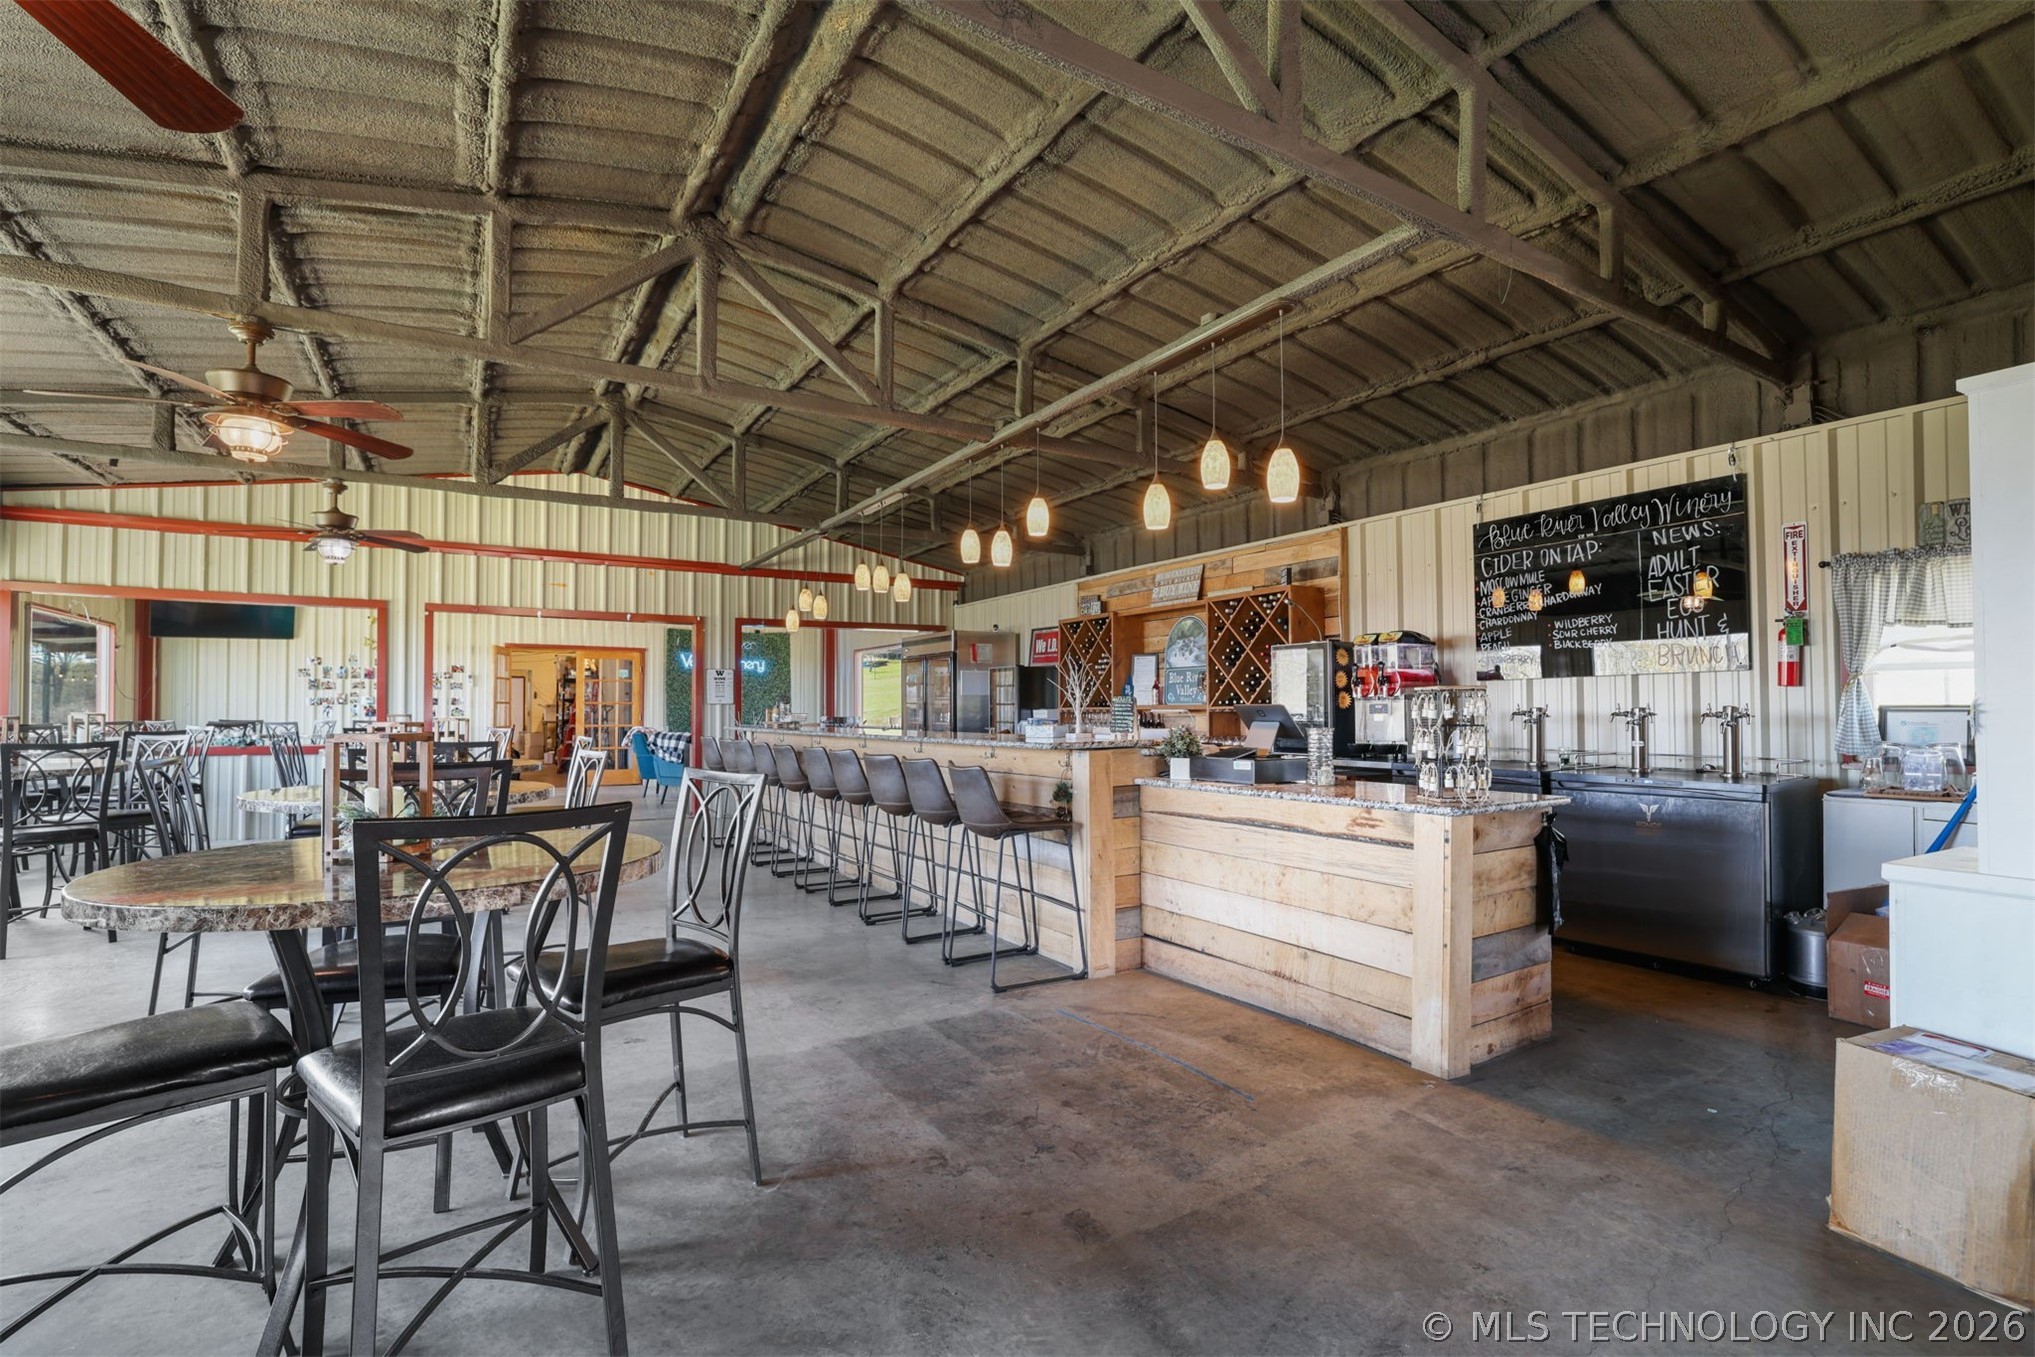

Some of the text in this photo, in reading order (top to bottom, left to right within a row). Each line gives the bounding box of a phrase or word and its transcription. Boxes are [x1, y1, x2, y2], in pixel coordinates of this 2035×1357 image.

[1479, 491, 1732, 551] Blue River Valley Winery
[1652, 521, 1721, 545] NEWS:
[1786, 530, 1803, 541] FIRE
[1480, 540, 1604, 578] CIDER ON TAP:
[1648, 545, 1700, 578] ADULT
[1480, 570, 1545, 597] MOSCOW MULE
[1648, 565, 1720, 602] EASTER
[1791, 540, 1800, 607] EXTINGUISHER
[1479, 599, 1536, 618] CRANBERR
[1480, 593, 1510, 607] APE
[1667, 596, 1705, 619] EGG
[1480, 612, 1538, 631] CHARDONNAY
[1552, 623, 1618, 640] SOUR CHERRY
[1554, 613, 1613, 630] WILDBERRY
[1657, 614, 1710, 640] HUNT
[1480, 627, 1512, 643] APPLE
[1169, 672, 1184, 684] Blue
[1175, 684, 1197, 698] Valley
